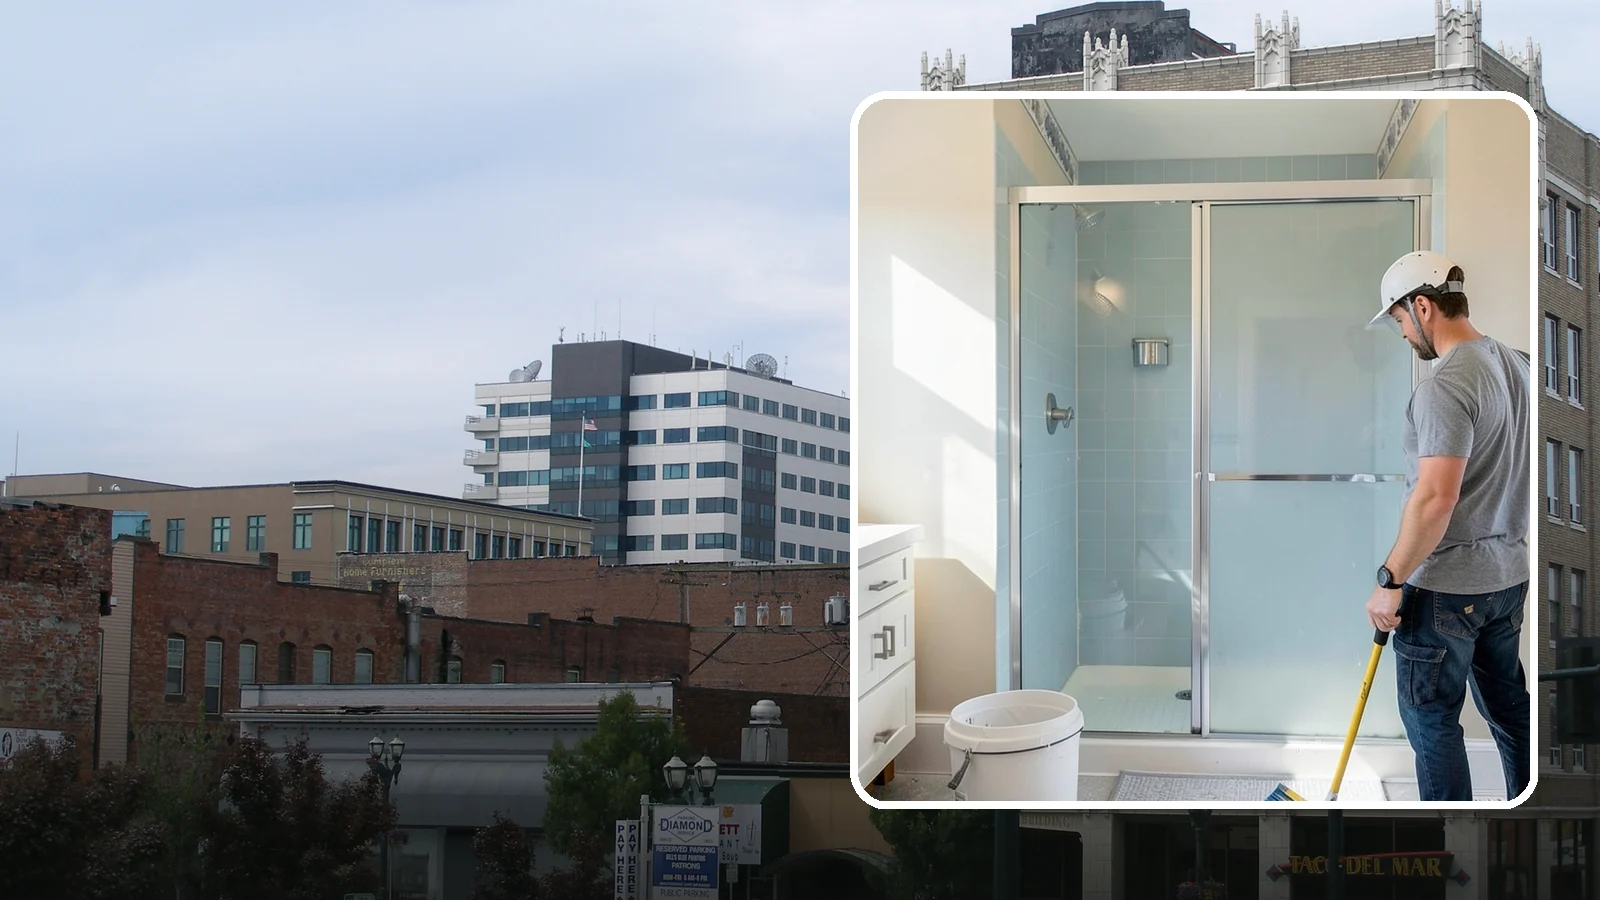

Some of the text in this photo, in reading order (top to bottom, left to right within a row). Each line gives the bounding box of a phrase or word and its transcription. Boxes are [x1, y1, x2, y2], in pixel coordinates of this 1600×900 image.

[660, 818, 713, 833] DIAMOND
[1021, 815, 1070, 828] BUILDING
[616, 825, 625, 894] PAY HERE
[627, 825, 637, 893] PAY HERE
[671, 862, 701, 870] PATRONS
[1346, 856, 1385, 876] DEL
[1392, 857, 1442, 877] MAR
[660, 889, 710, 899] PUBLIC PARKING
